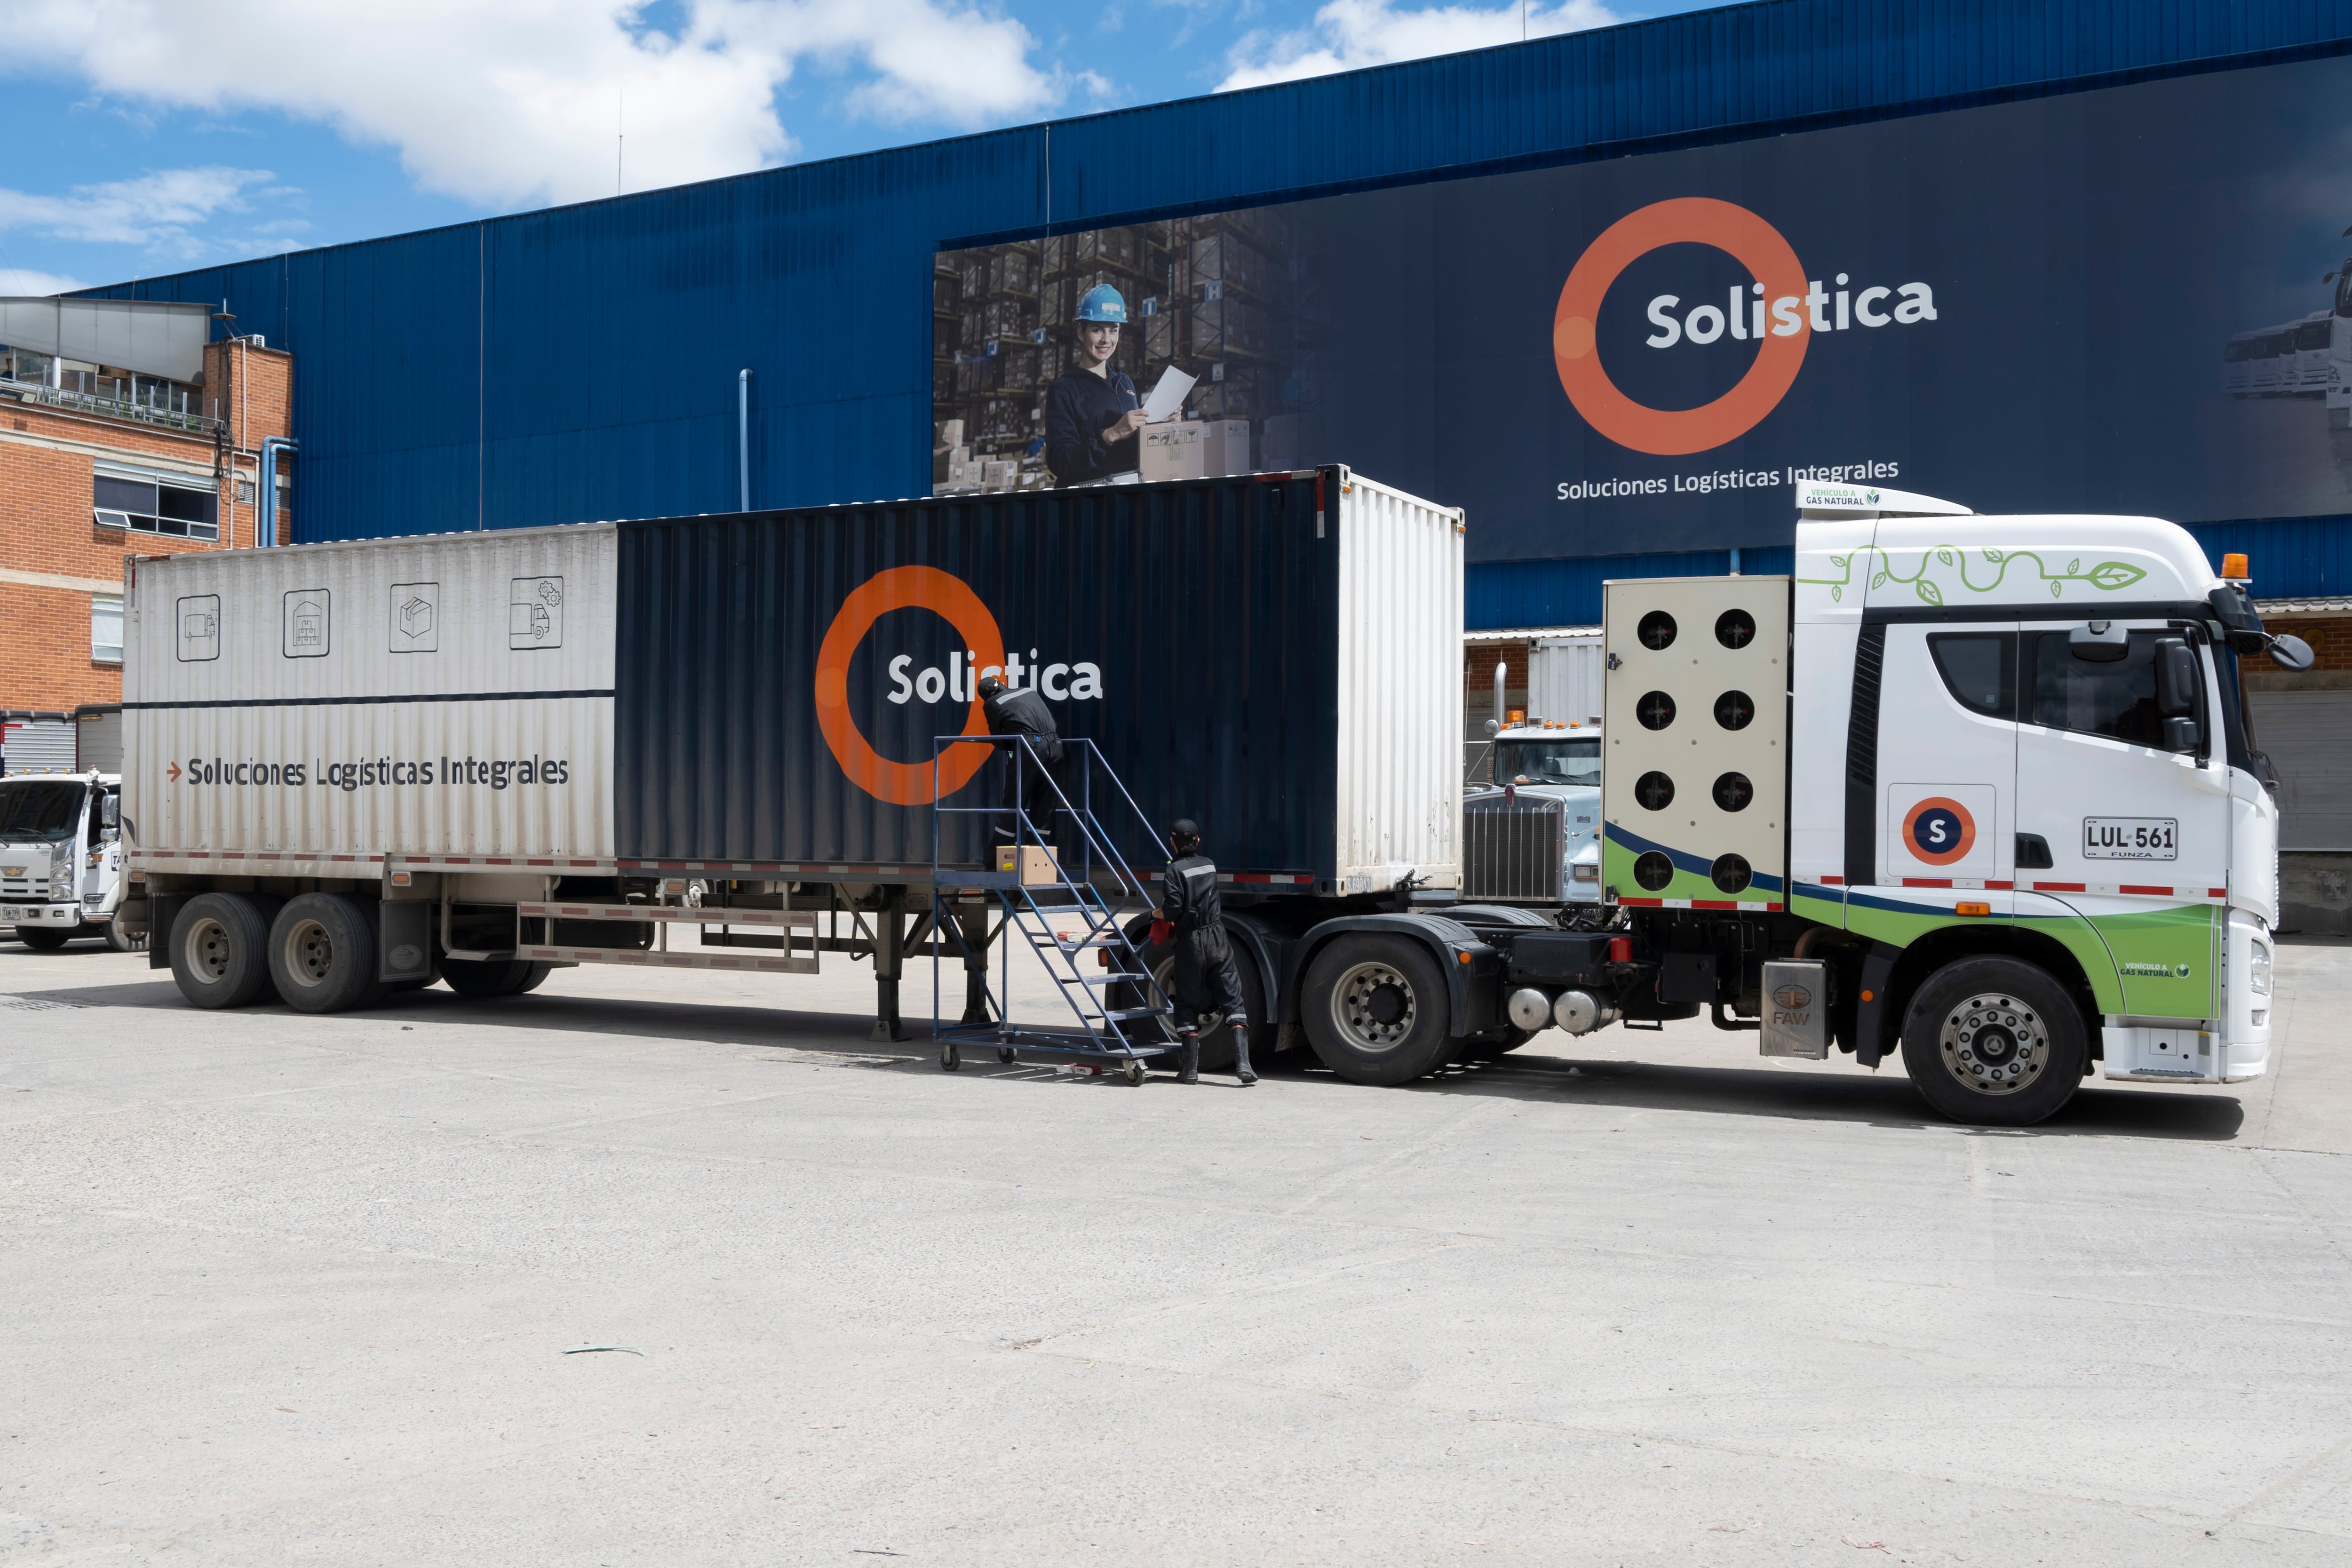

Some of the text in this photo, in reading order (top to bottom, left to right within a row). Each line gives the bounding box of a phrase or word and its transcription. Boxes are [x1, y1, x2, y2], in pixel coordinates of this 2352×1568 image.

[1645, 273, 1938, 349] Solistica
[1557, 460, 1899, 500] Soluciones Logísticas Integrales
[1811, 488, 1848, 497] VEHÍCULO
[1825, 496, 1864, 505] NATURAL
[188, 754, 568, 791] Soluciones Logísticas Integrales
[1930, 819, 1946, 844] S
[2088, 827, 2173, 848] LUL 561
[1773, 1011, 1810, 1026] FAW
